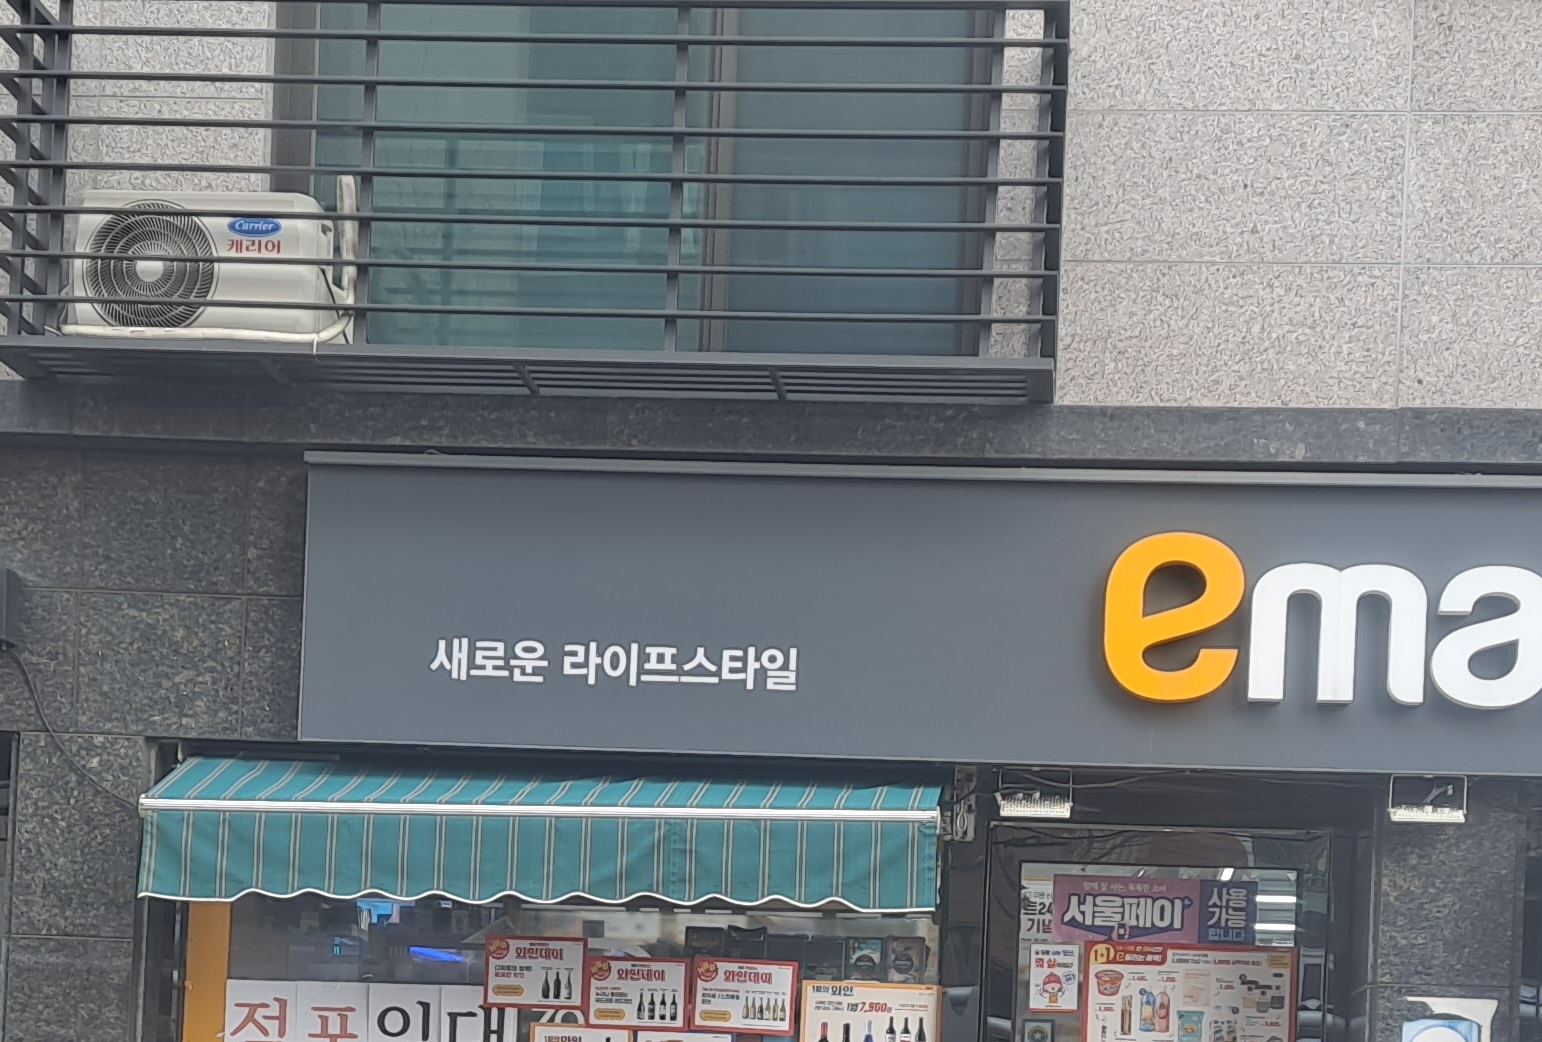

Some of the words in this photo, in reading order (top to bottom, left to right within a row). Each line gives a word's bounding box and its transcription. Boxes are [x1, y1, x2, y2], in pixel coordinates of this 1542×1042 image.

[235, 218, 274, 231] Carrier
[227, 239, 281, 254] 캐리어
[429, 637, 548, 684] 새로운
[563, 641, 800, 691] 라이프스타일
[1207, 887, 1248, 909] 사용
[1207, 908, 1247, 928] 가능
[1207, 929, 1246, 942] 합니다
